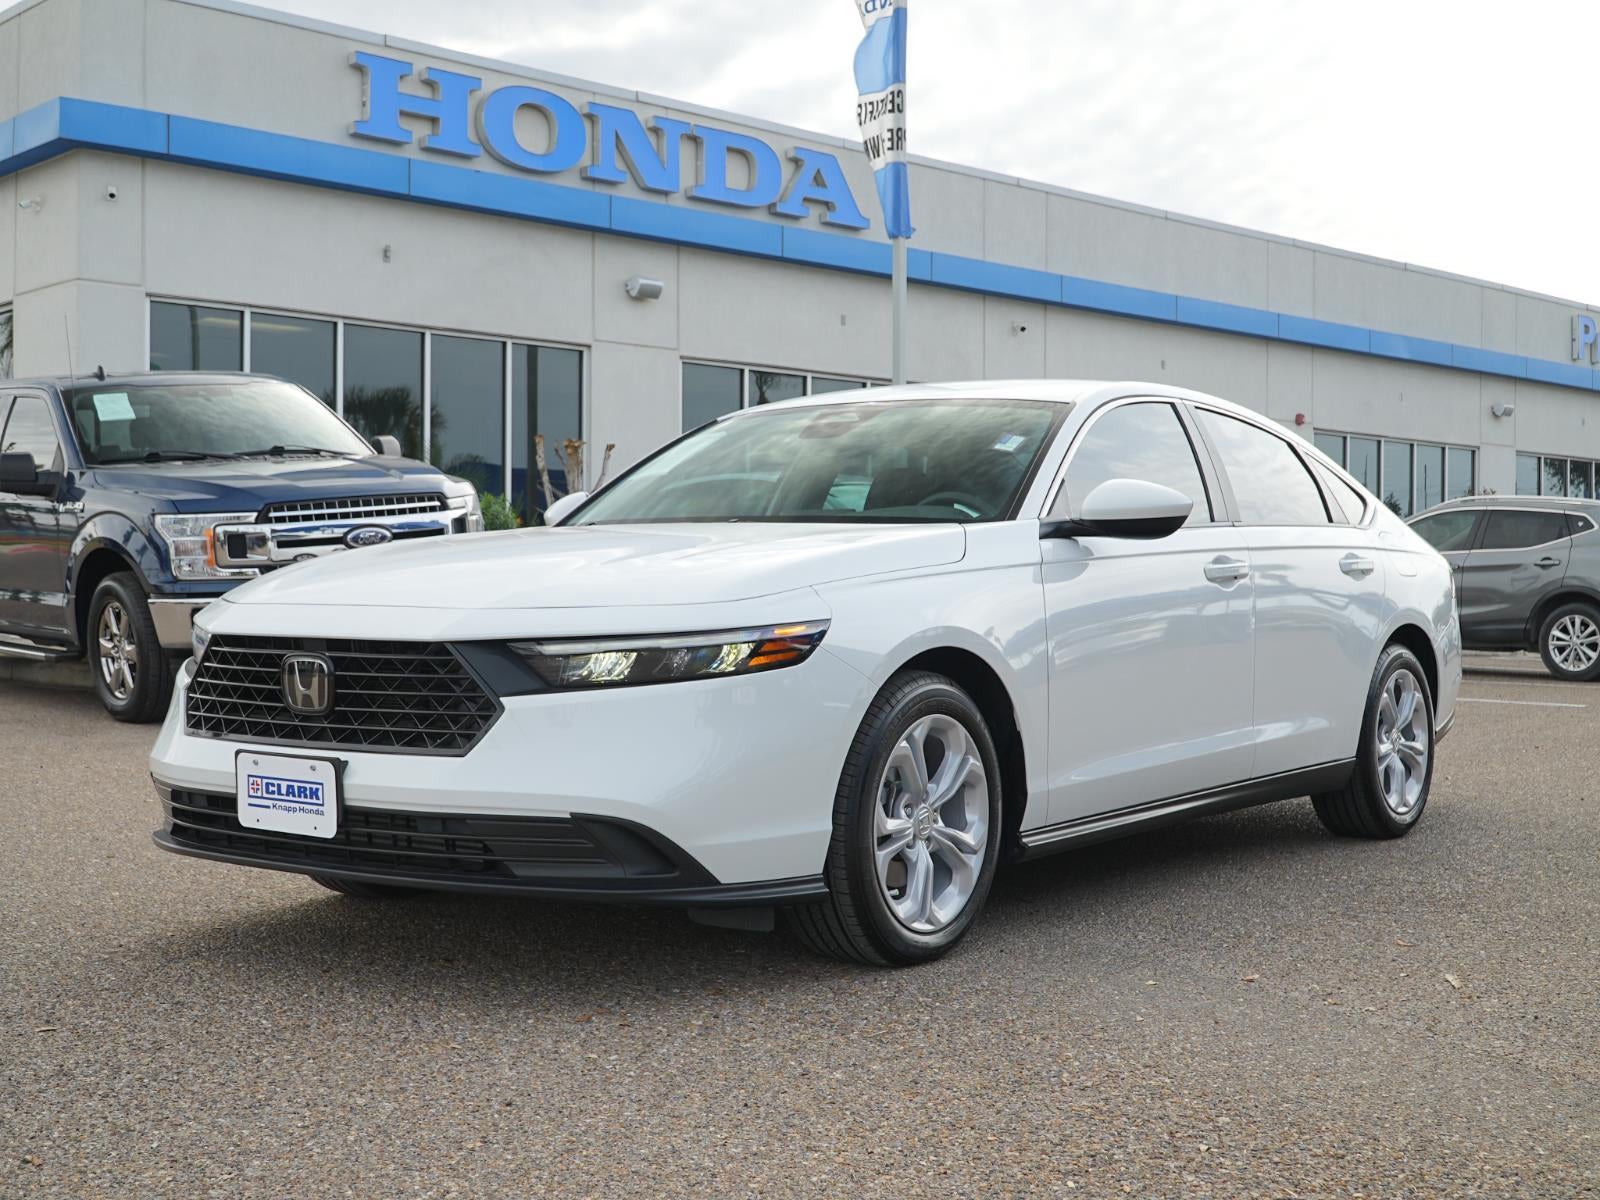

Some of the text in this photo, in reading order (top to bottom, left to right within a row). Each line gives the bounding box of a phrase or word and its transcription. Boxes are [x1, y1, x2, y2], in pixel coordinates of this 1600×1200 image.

[349, 50, 870, 230] HONDA
[1573, 314, 1600, 362] P
[264, 782, 321, 800] CLARK
[272, 803, 325, 816] Knapp Honda
